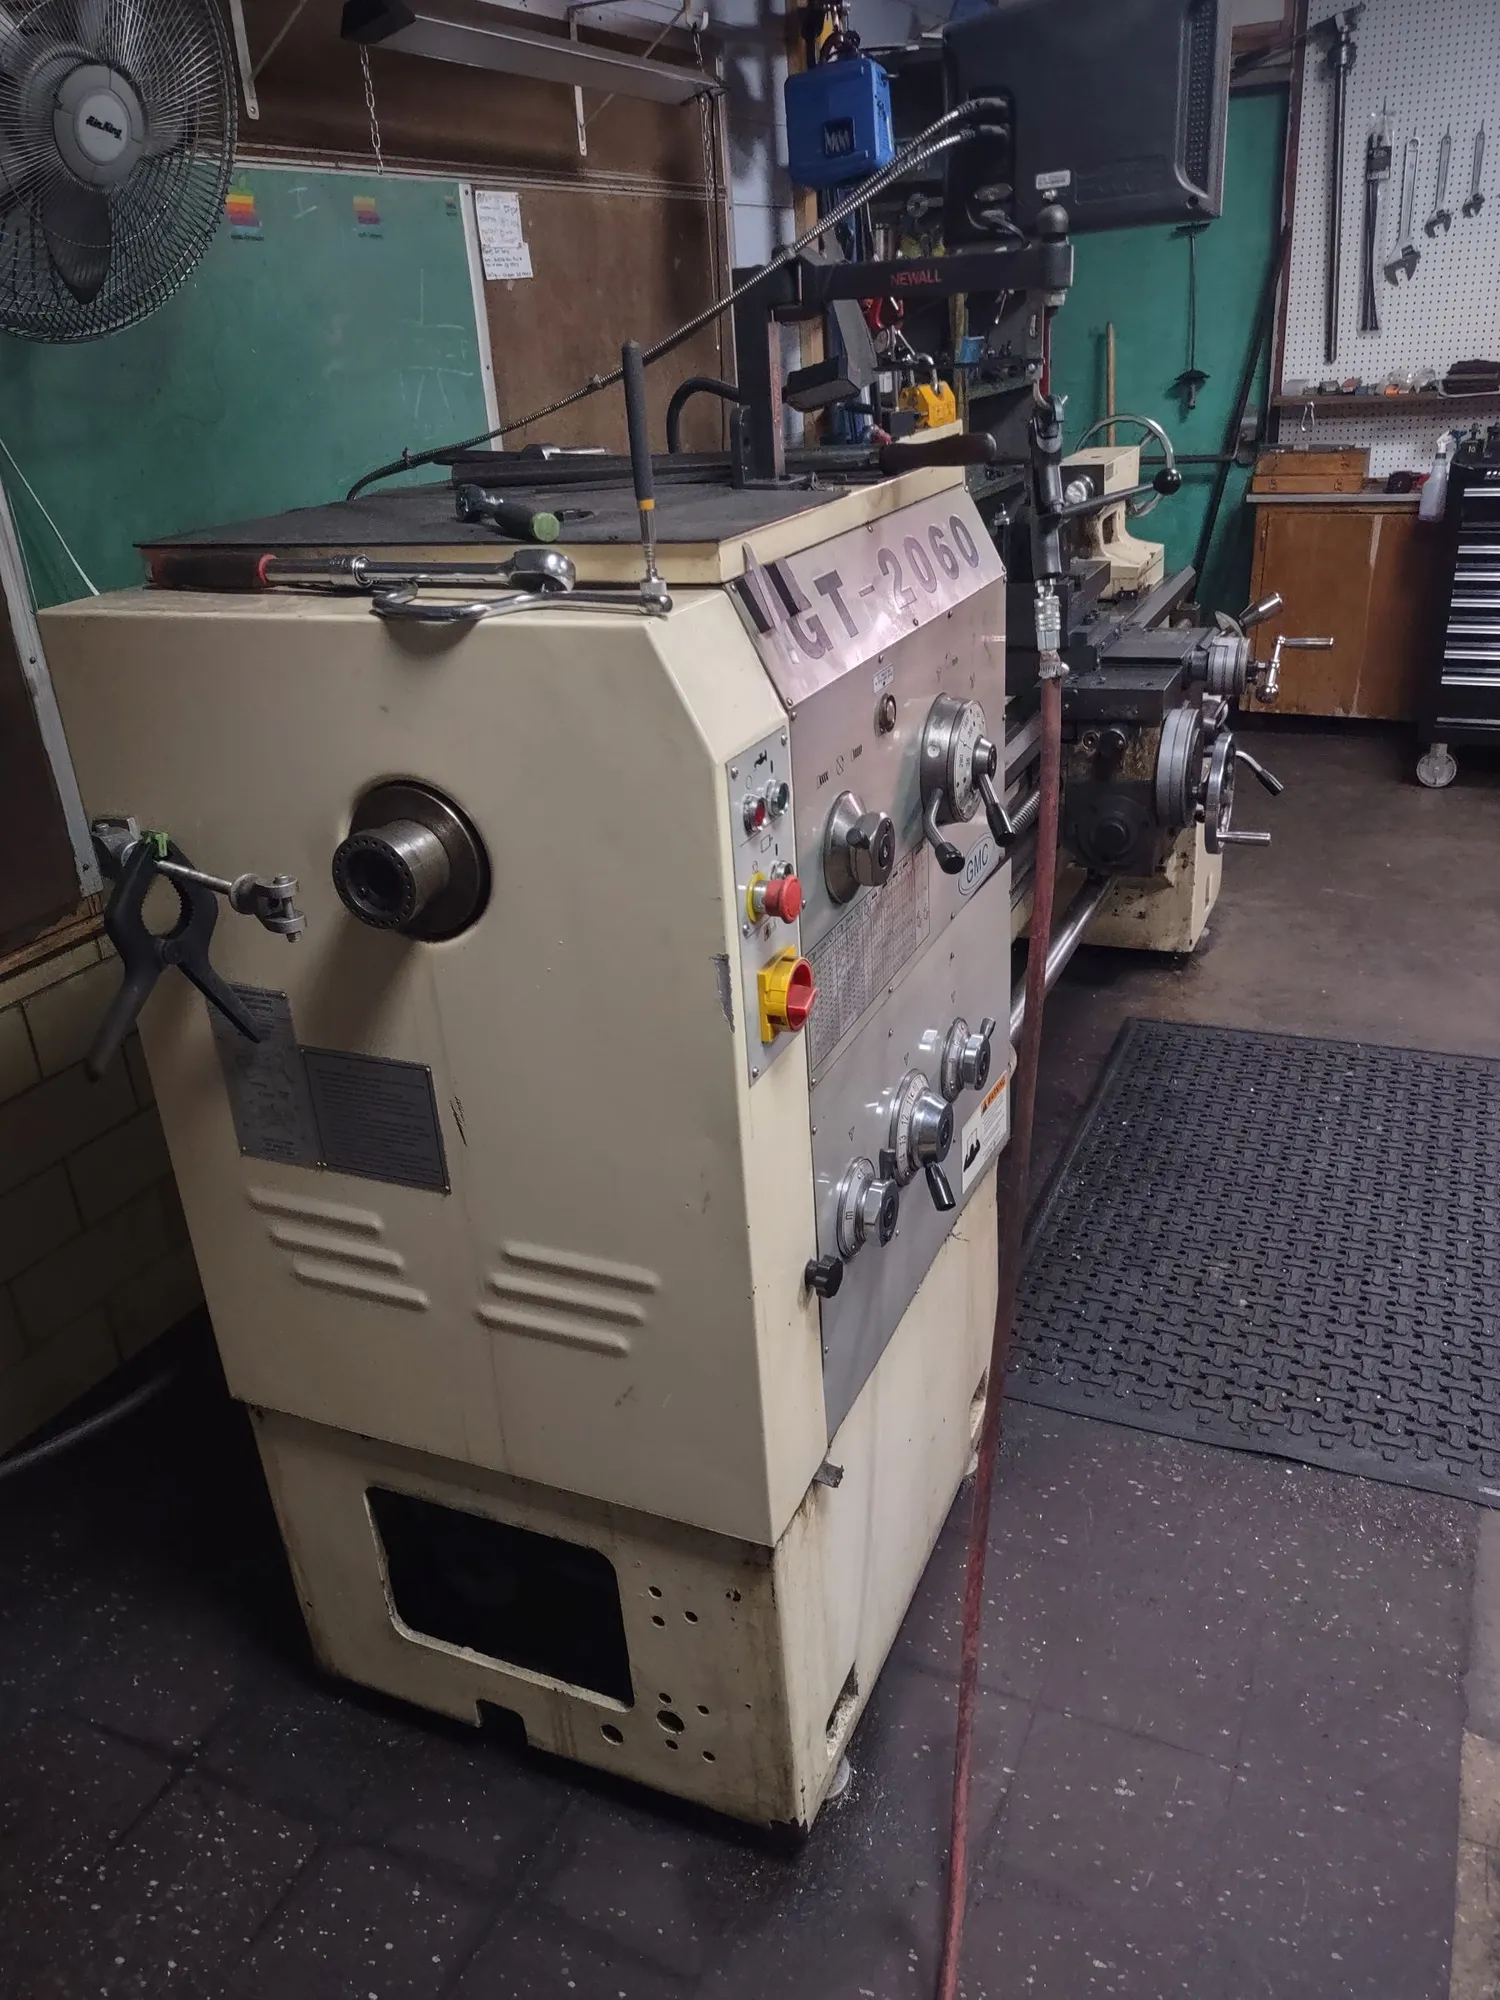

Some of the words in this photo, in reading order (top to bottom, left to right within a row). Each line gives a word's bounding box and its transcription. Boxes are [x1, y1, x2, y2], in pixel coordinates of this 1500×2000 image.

[890, 268, 943, 287] NEWALL
[786, 515, 980, 660] GT-2060
[965, 843, 990, 884] GMC
[901, 1114, 909, 1125] 12
[898, 1134, 907, 1146] 13
